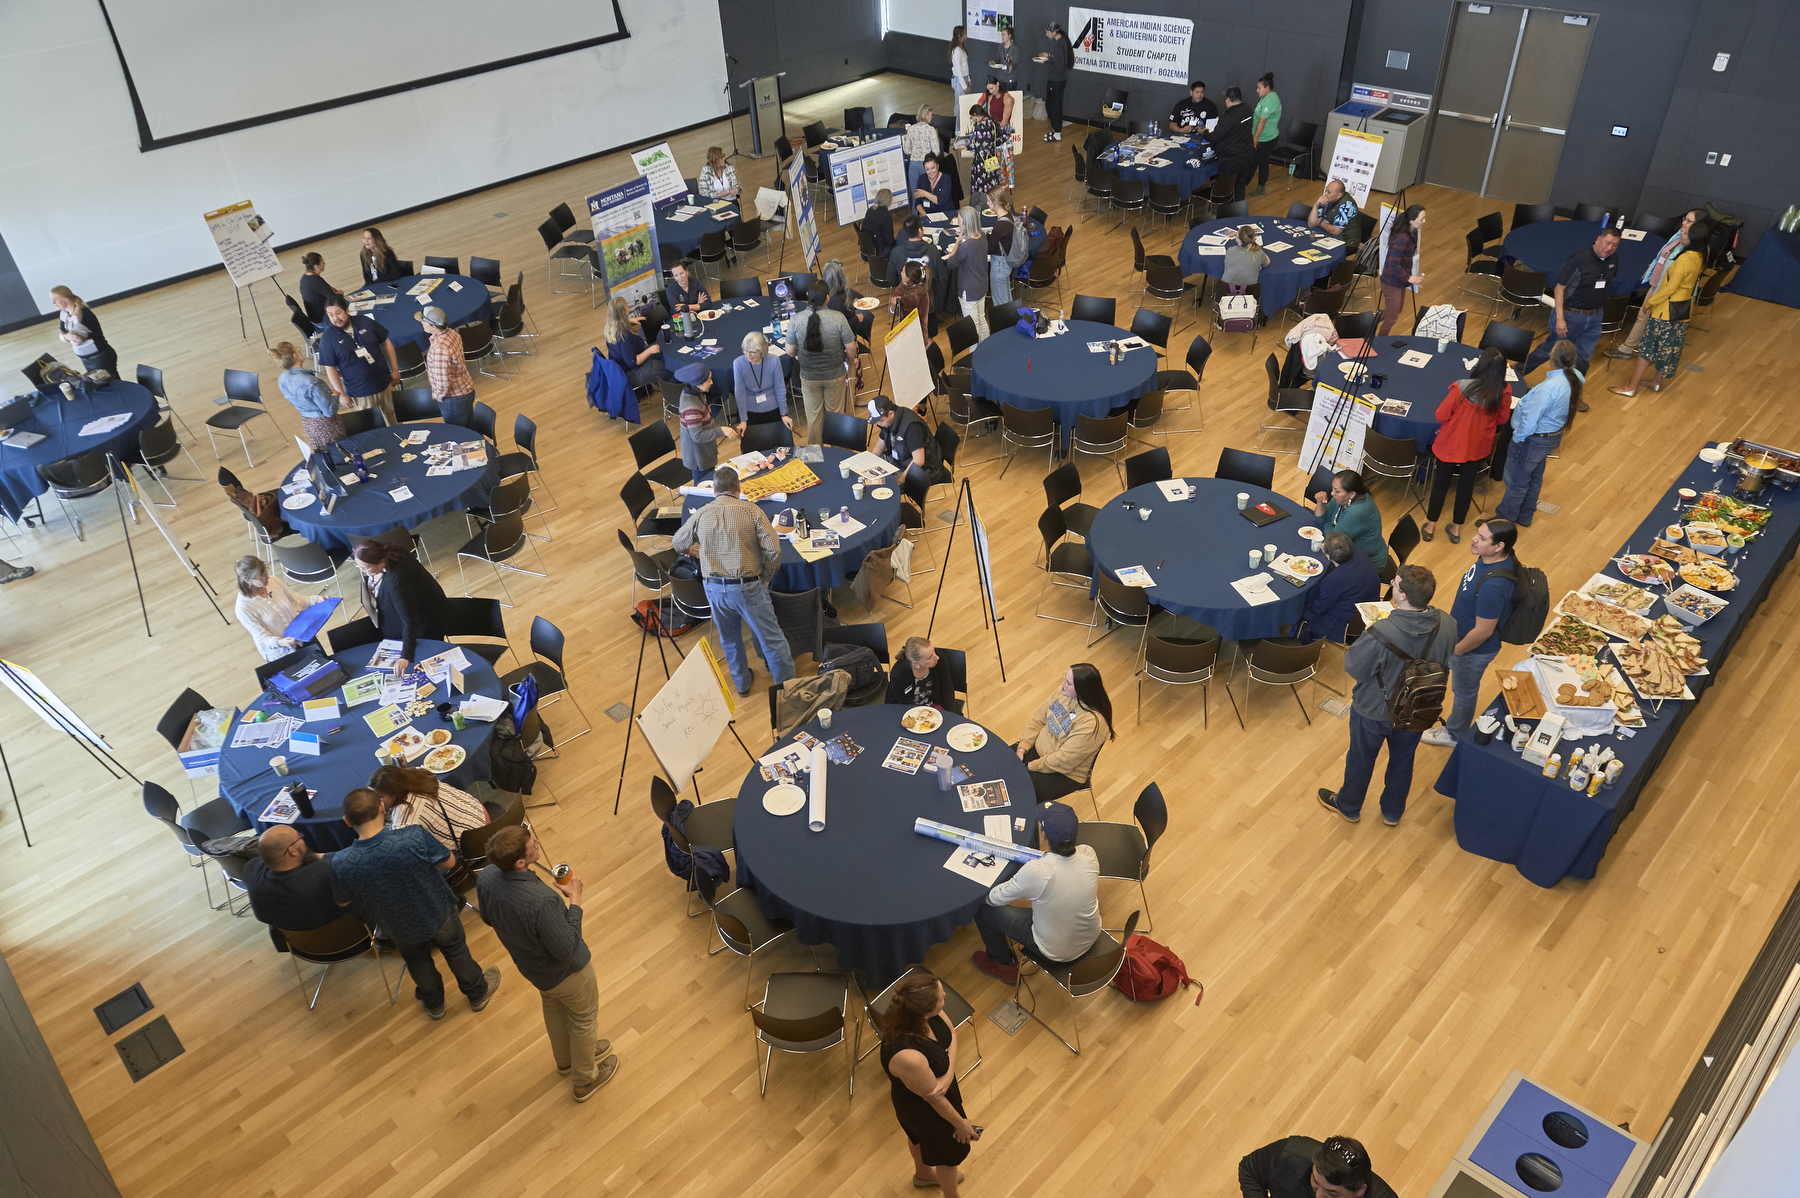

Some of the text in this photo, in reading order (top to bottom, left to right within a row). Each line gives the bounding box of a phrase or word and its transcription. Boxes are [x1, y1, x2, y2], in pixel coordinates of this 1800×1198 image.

[1106, 18, 1191, 36] AMERICAN INDIAN SCIENCE
[1115, 29, 1158, 43] ENGINEERING
[1158, 34, 1186, 46] SOCIETY
[1116, 46, 1177, 62] STUDENT CHAPTER
[1074, 56, 1098, 68] ONTANA
[1098, 59, 1117, 71] STATE
[1118, 62, 1153, 75] UNIVERSITY
[1158, 68, 1188, 79] BOZEMAN
[600, 191, 624, 204] MONTANA
[653, 698, 673, 724] Solar
